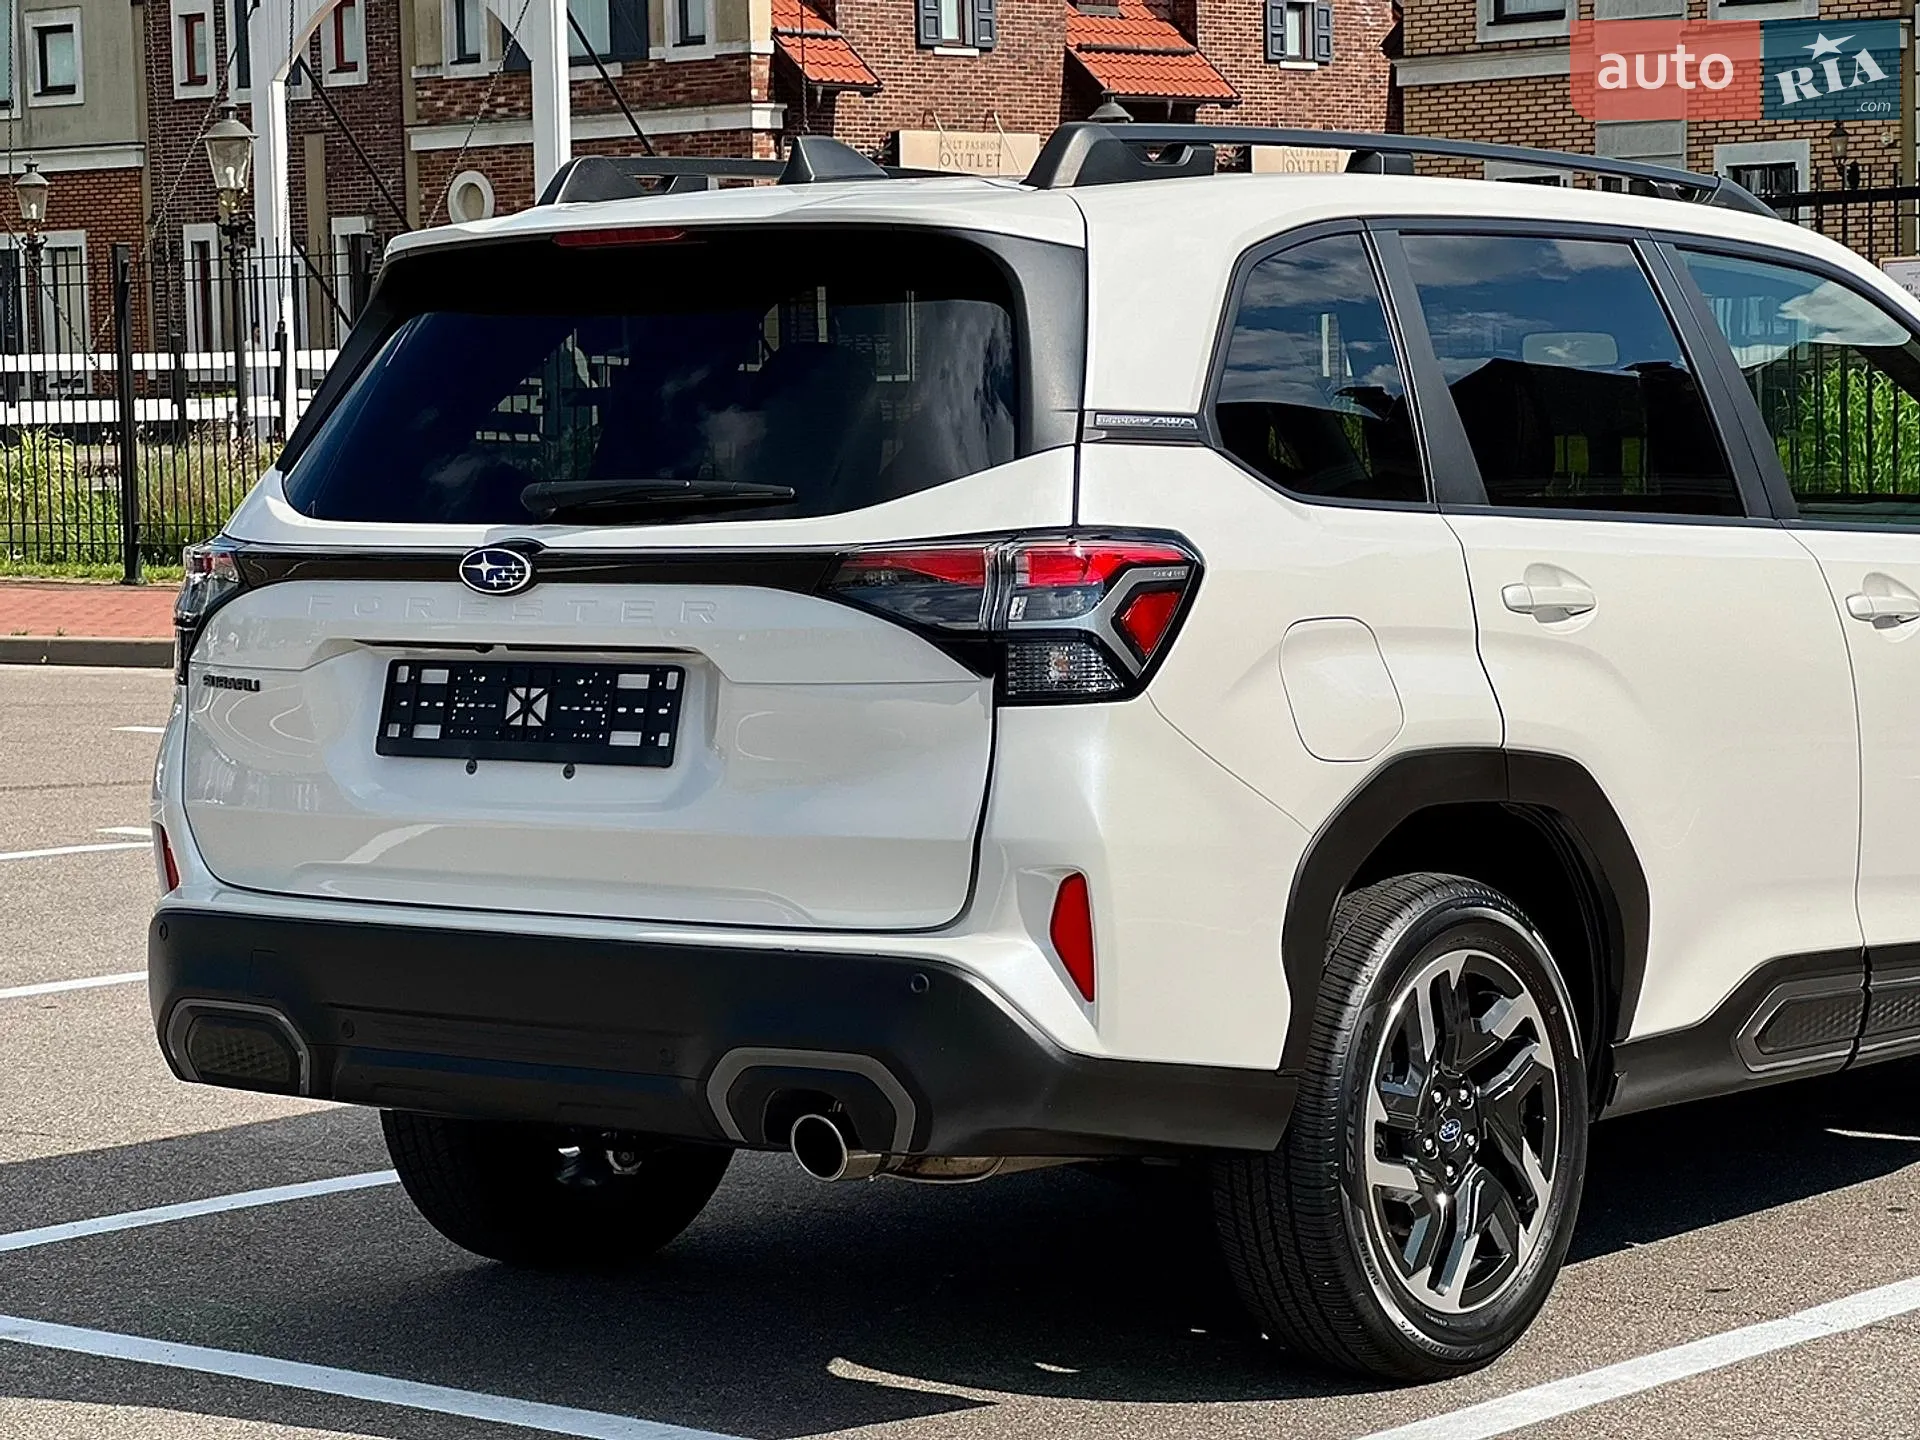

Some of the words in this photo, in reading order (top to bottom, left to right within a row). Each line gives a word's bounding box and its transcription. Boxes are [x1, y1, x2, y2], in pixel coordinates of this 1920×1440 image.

[941, 152, 1002, 168] OUTLET
[306, 594, 719, 625] FORESTER
[203, 674, 260, 692] SUBARU
